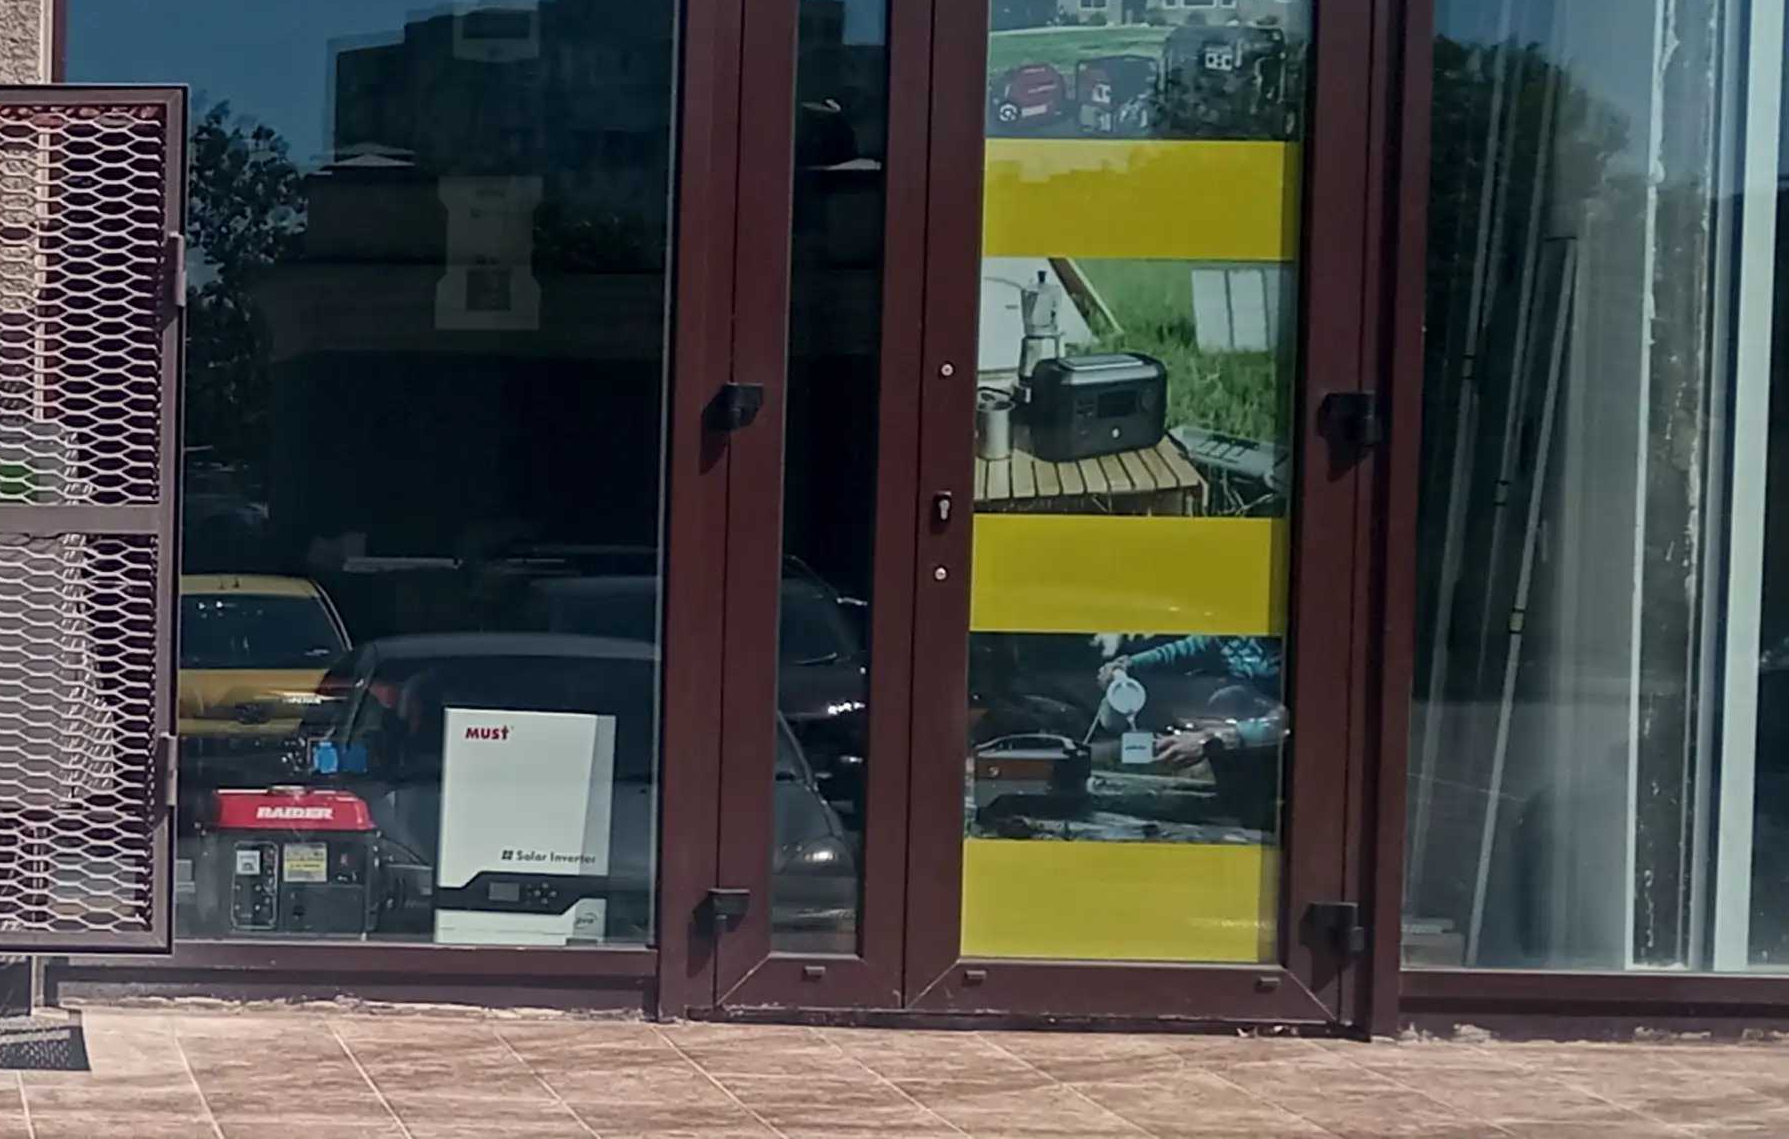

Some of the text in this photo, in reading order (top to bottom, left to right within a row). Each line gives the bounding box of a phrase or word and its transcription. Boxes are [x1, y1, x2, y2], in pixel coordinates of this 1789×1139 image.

[257, 806, 334, 820] RAIDER
[516, 850, 596, 865] Solar Inverter
